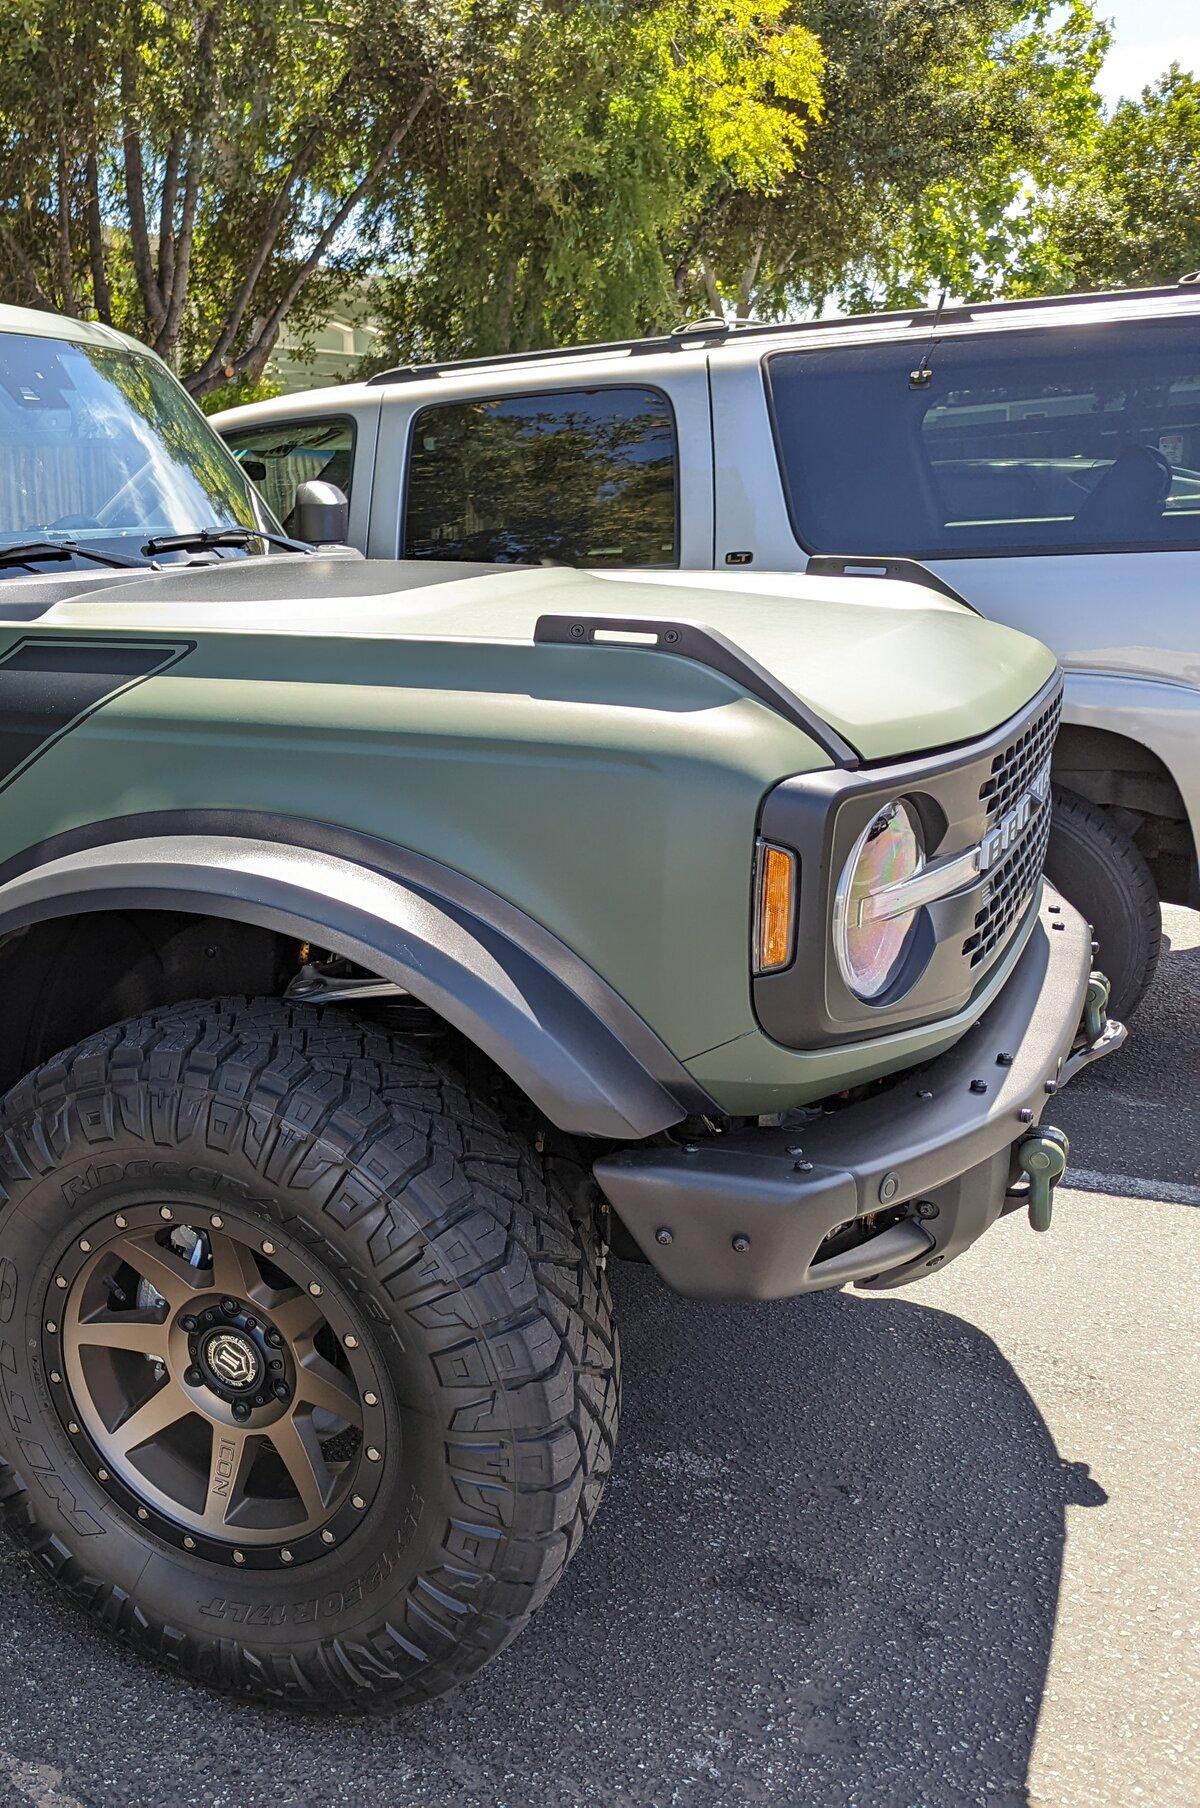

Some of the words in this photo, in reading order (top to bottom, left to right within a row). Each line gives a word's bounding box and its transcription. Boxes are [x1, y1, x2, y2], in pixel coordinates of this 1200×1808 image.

[727, 553, 750, 563] LT
[60, 1159, 183, 1208] RIDGE
[211, 1437, 236, 1498] ICON
